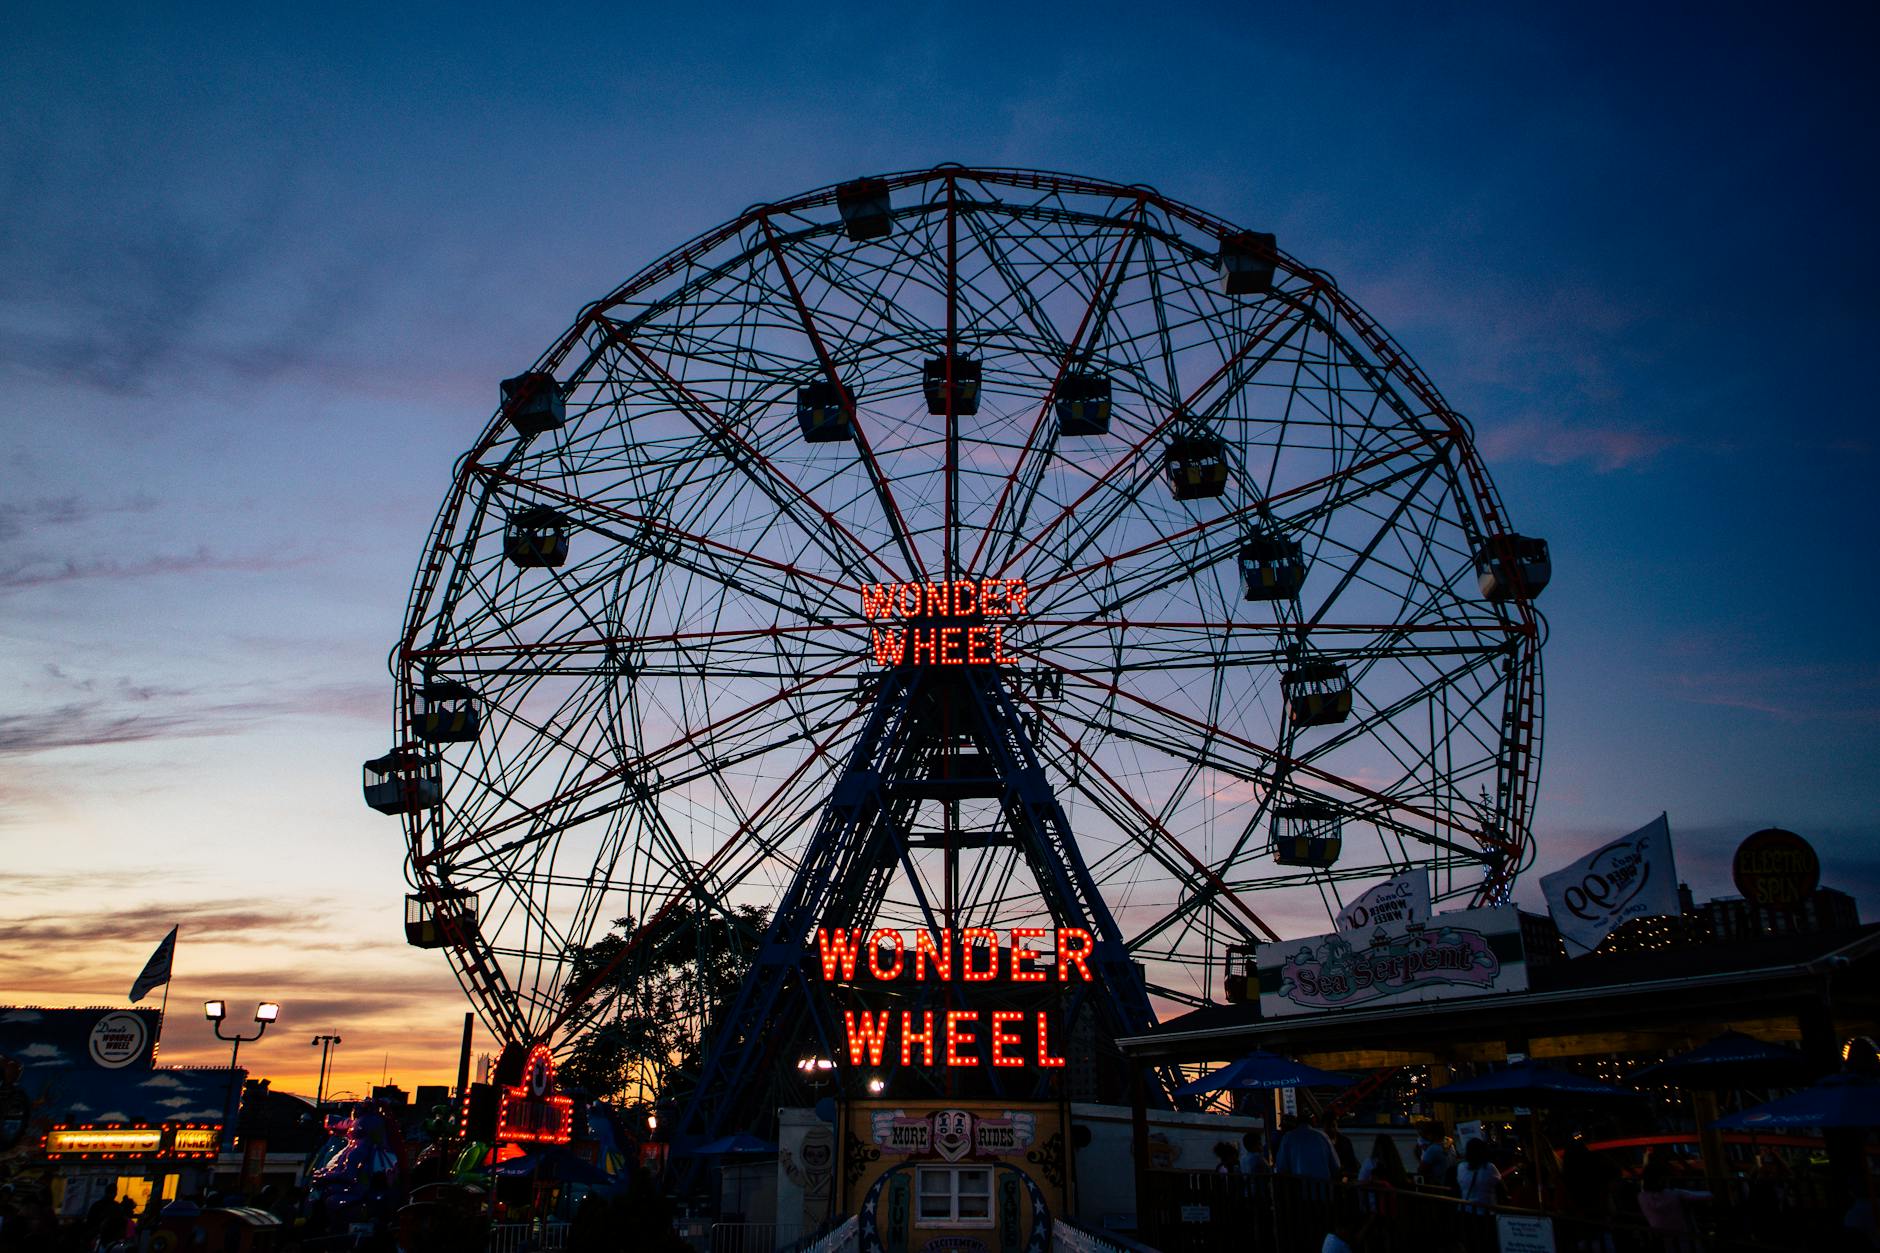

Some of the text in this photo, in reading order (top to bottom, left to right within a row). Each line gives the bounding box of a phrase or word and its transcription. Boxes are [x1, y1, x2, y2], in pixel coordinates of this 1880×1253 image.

[861, 578, 1028, 619] WONDER
[872, 627, 1018, 665] WHEEL
[1756, 878, 1800, 903] SPIN
[818, 928, 1094, 981] WONDER
[1299, 943, 1475, 996] Sea Serpent
[845, 1011, 1066, 1066] WHEEL
[1263, 1076, 1301, 1088] pepsi
[892, 1127, 1014, 1146] MORE RIDES
[893, 1187, 905, 1244] FUN
[1004, 1181, 1017, 1247] GAMES
[929, 1238, 983, 1250] EXCITEMENT
